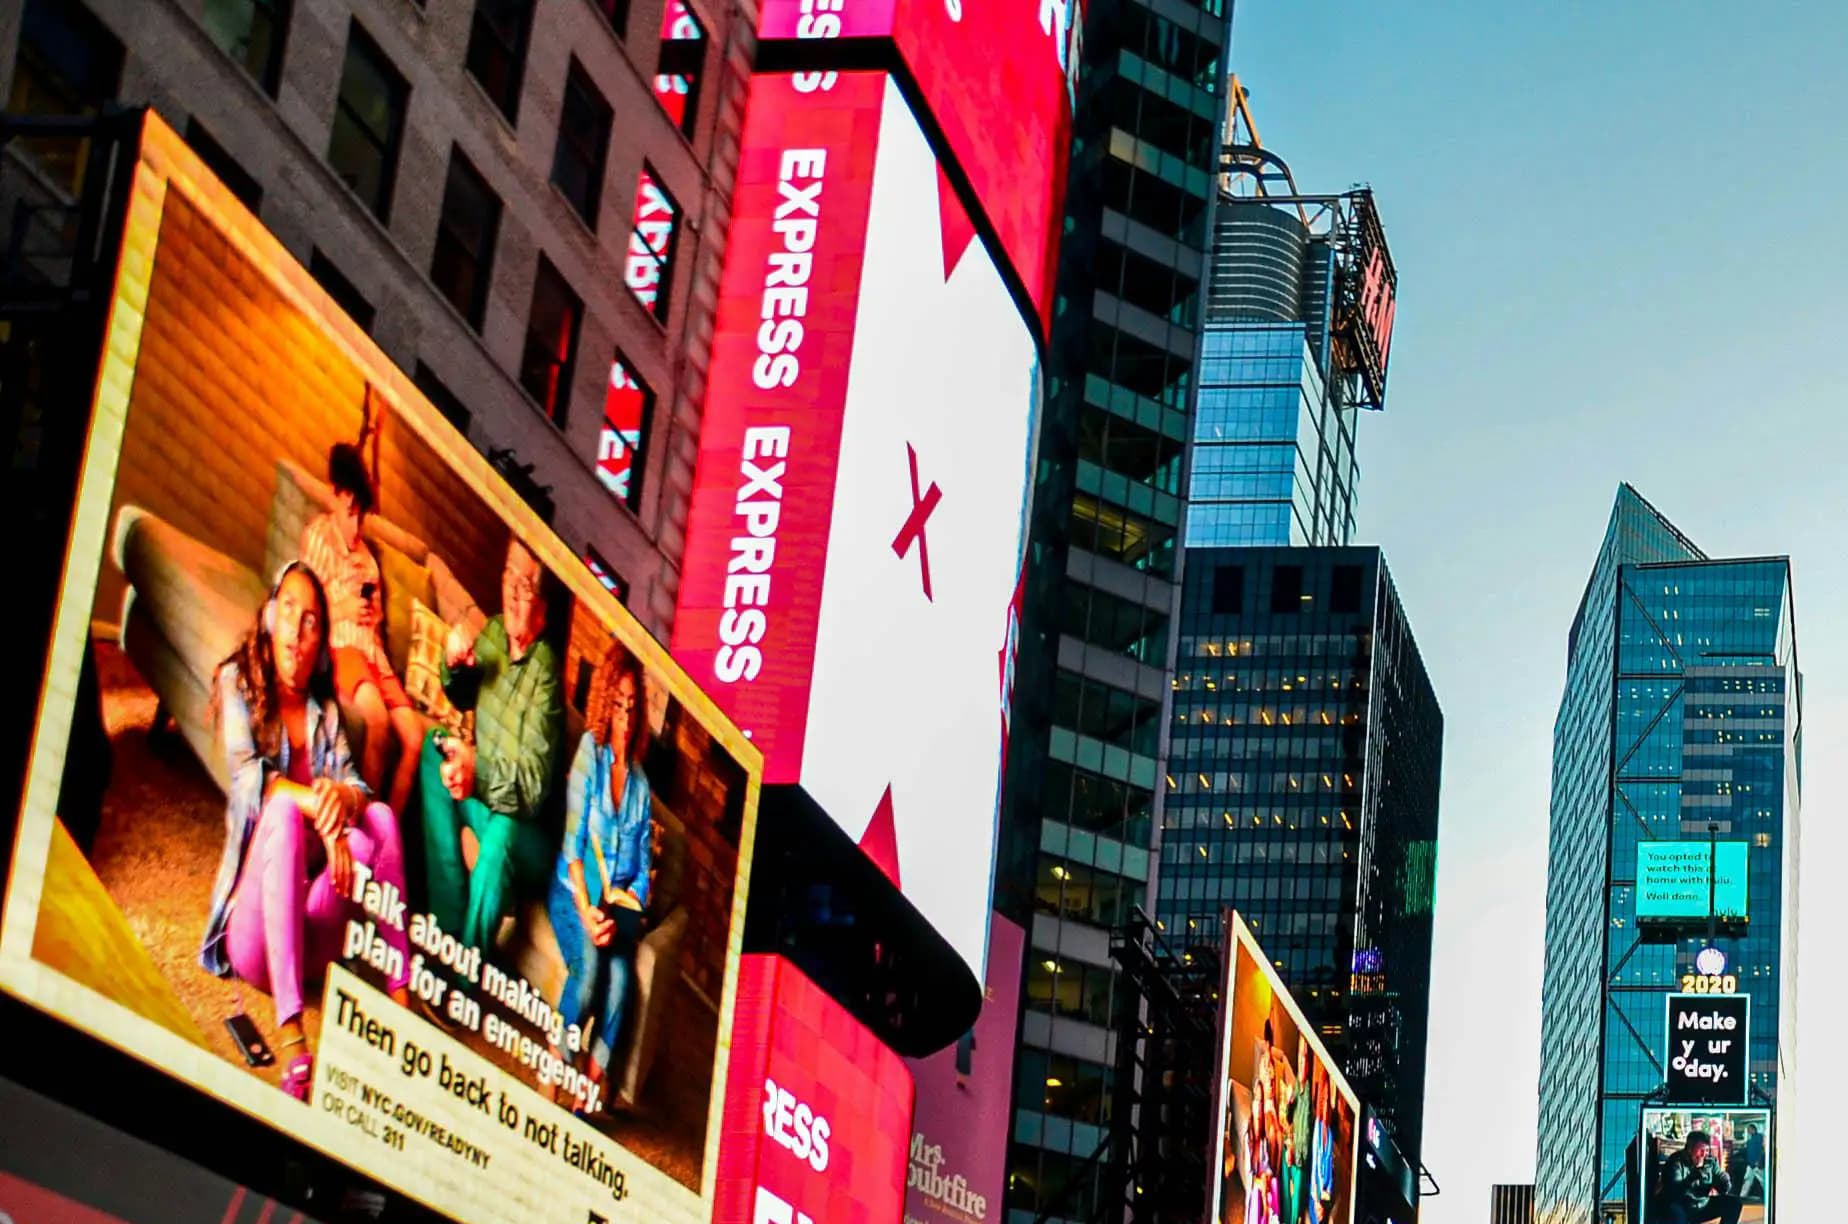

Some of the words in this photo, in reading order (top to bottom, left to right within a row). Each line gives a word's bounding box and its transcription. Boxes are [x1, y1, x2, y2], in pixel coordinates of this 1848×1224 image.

[752, 148, 826, 390] EXPRESS
[714, 426, 790, 683] EXPRESS
[345, 920, 404, 982] plan
[408, 956, 443, 1007] for
[448, 990, 481, 1032] an
[484, 1015, 602, 1114] emergency.
[351, 861, 406, 932] Talk
[409, 913, 482, 984] about
[484, 962, 564, 1051] making
[566, 1022, 581, 1052] a
[1678, 1011, 1737, 1031] Make
[1681, 975, 1737, 994] 2020
[321, 1092, 345, 1120] OR
[345, 1103, 379, 1141] CALL
[382, 1124, 406, 1153] 311
[326, 1063, 360, 1100] VISIT
[335, 987, 397, 1058] Then
[402, 1033, 432, 1079] go
[439, 1053, 492, 1114] back
[497, 1095, 519, 1132] to
[524, 1113, 560, 1155] not
[563, 1131, 629, 1200] talking.
